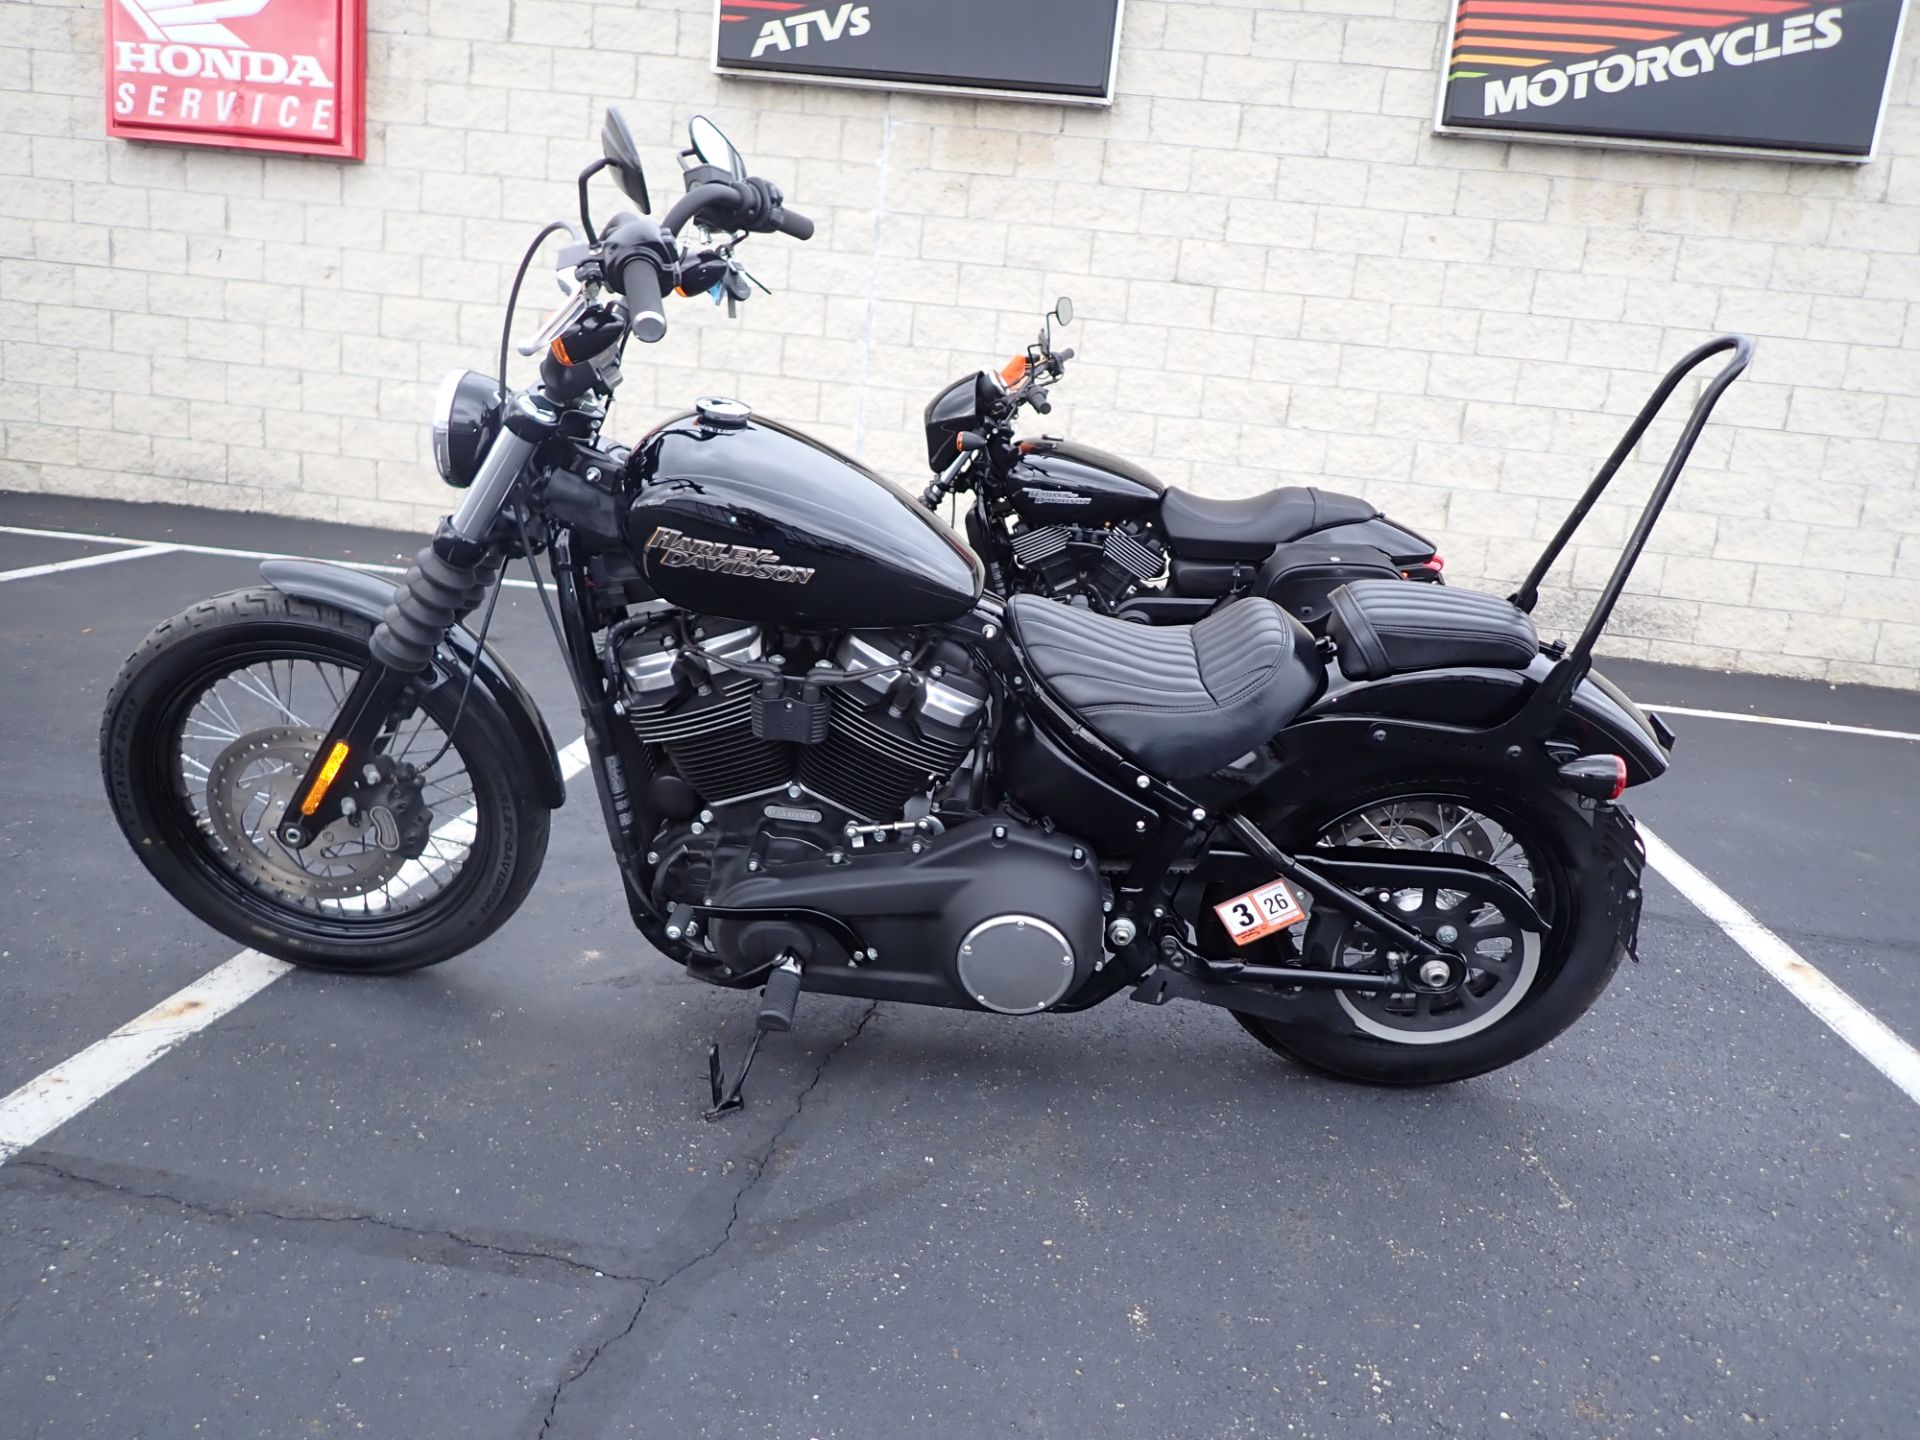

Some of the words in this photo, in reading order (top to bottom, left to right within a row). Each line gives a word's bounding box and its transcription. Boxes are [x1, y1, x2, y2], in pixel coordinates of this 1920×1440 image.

[115, 41, 334, 88] HONDA
[1484, 8, 1843, 116] MOTORCYCLES
[115, 82, 333, 131] SERVICE
[660, 549, 815, 584] DAVIDSON
[1232, 903, 1255, 927] 3
[1264, 893, 1289, 915] 26
